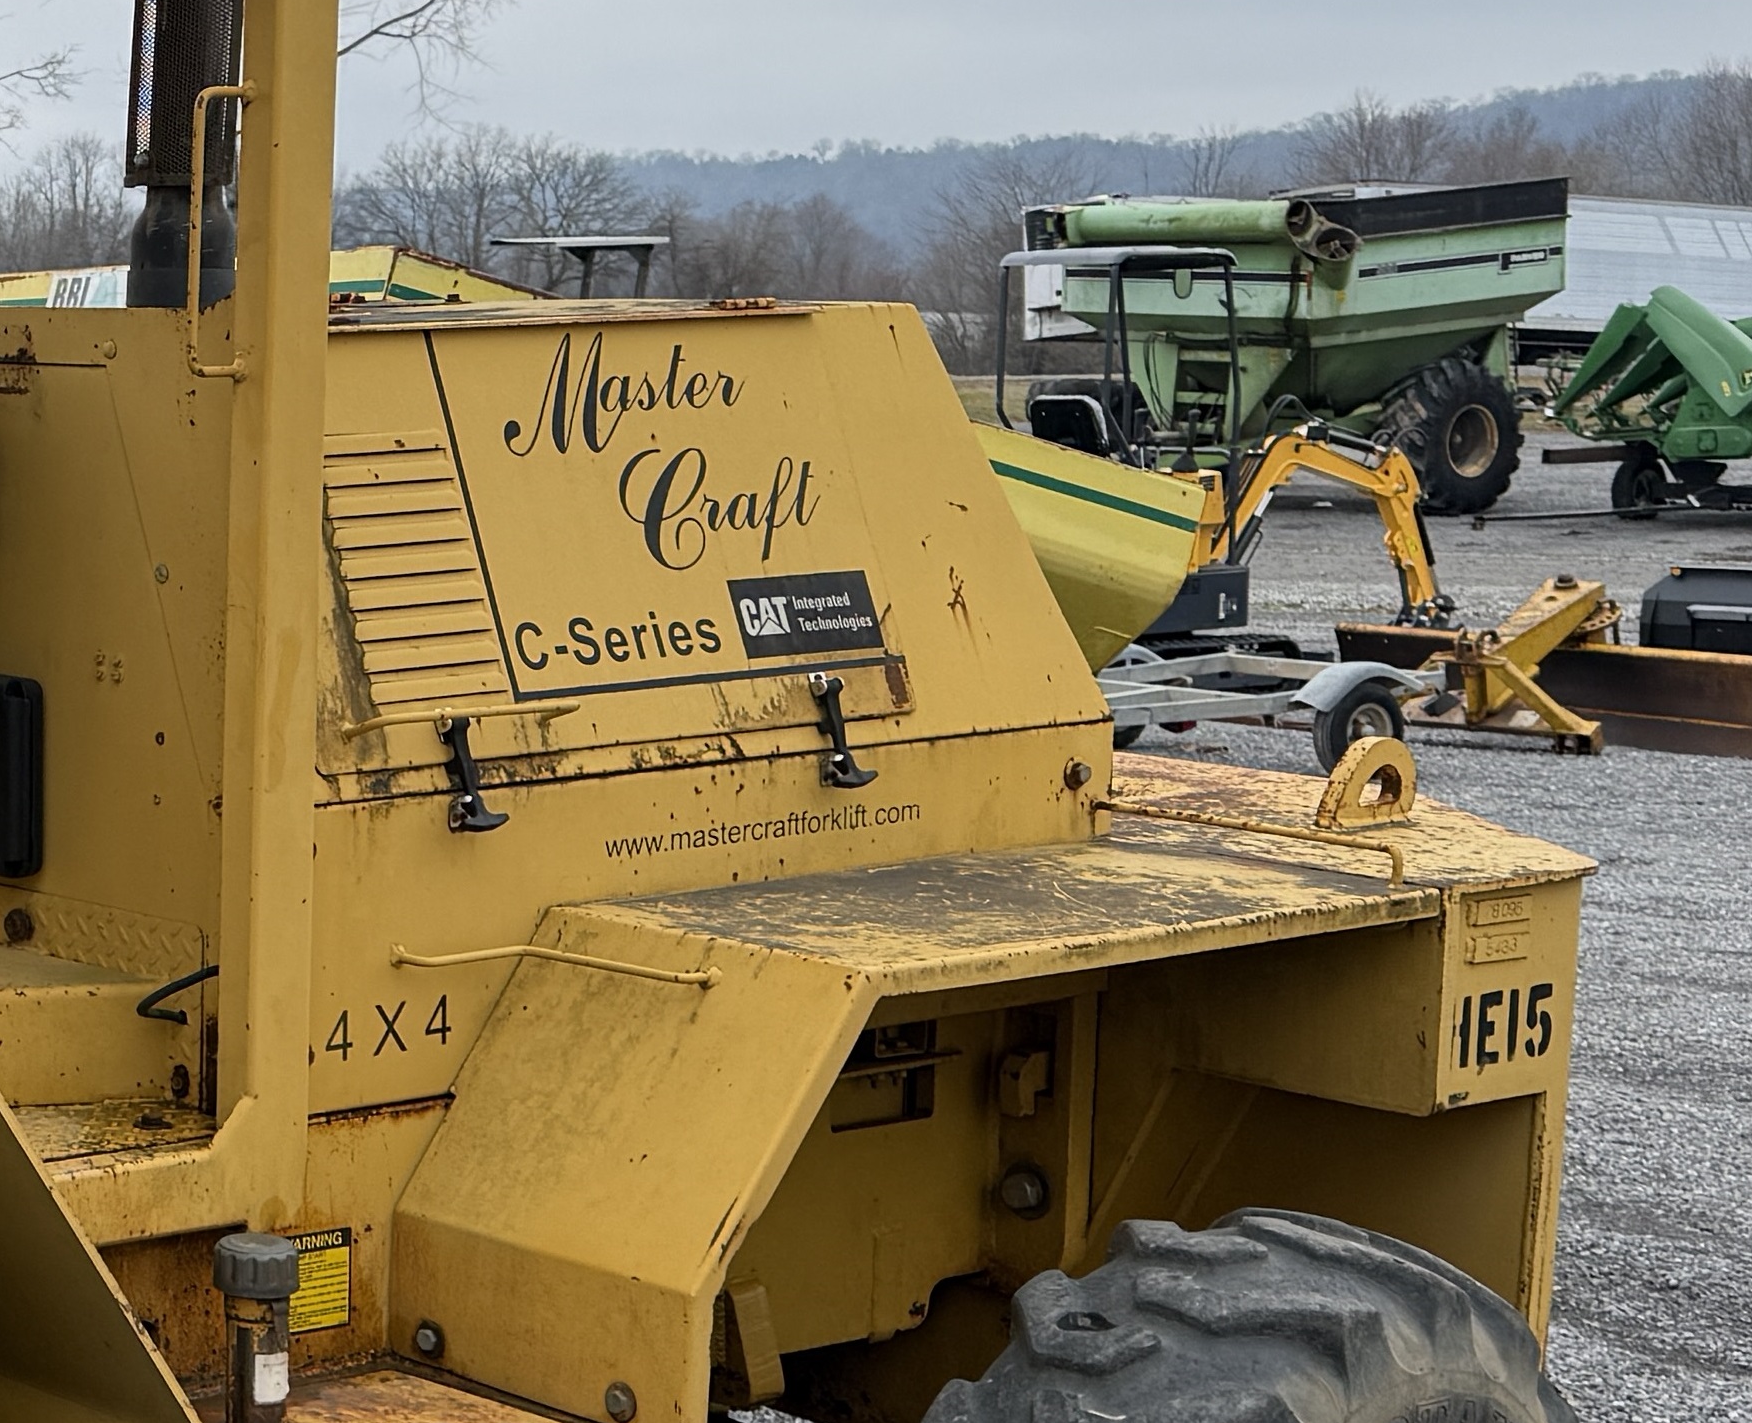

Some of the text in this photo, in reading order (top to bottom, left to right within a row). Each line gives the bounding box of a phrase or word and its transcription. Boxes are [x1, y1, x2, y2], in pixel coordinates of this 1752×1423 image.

[504, 330, 745, 457] Master
[619, 447, 820, 570] Craft
[739, 596, 791, 637] CAT
[792, 592, 851, 612] Integrated
[797, 613, 873, 632] Technologies
[514, 611, 722, 671] C-Series
[605, 800, 921, 860] www.mastercraftforklift.com
[325, 993, 452, 1062] 4 X 4
[291, 1231, 343, 1251] ARNING
